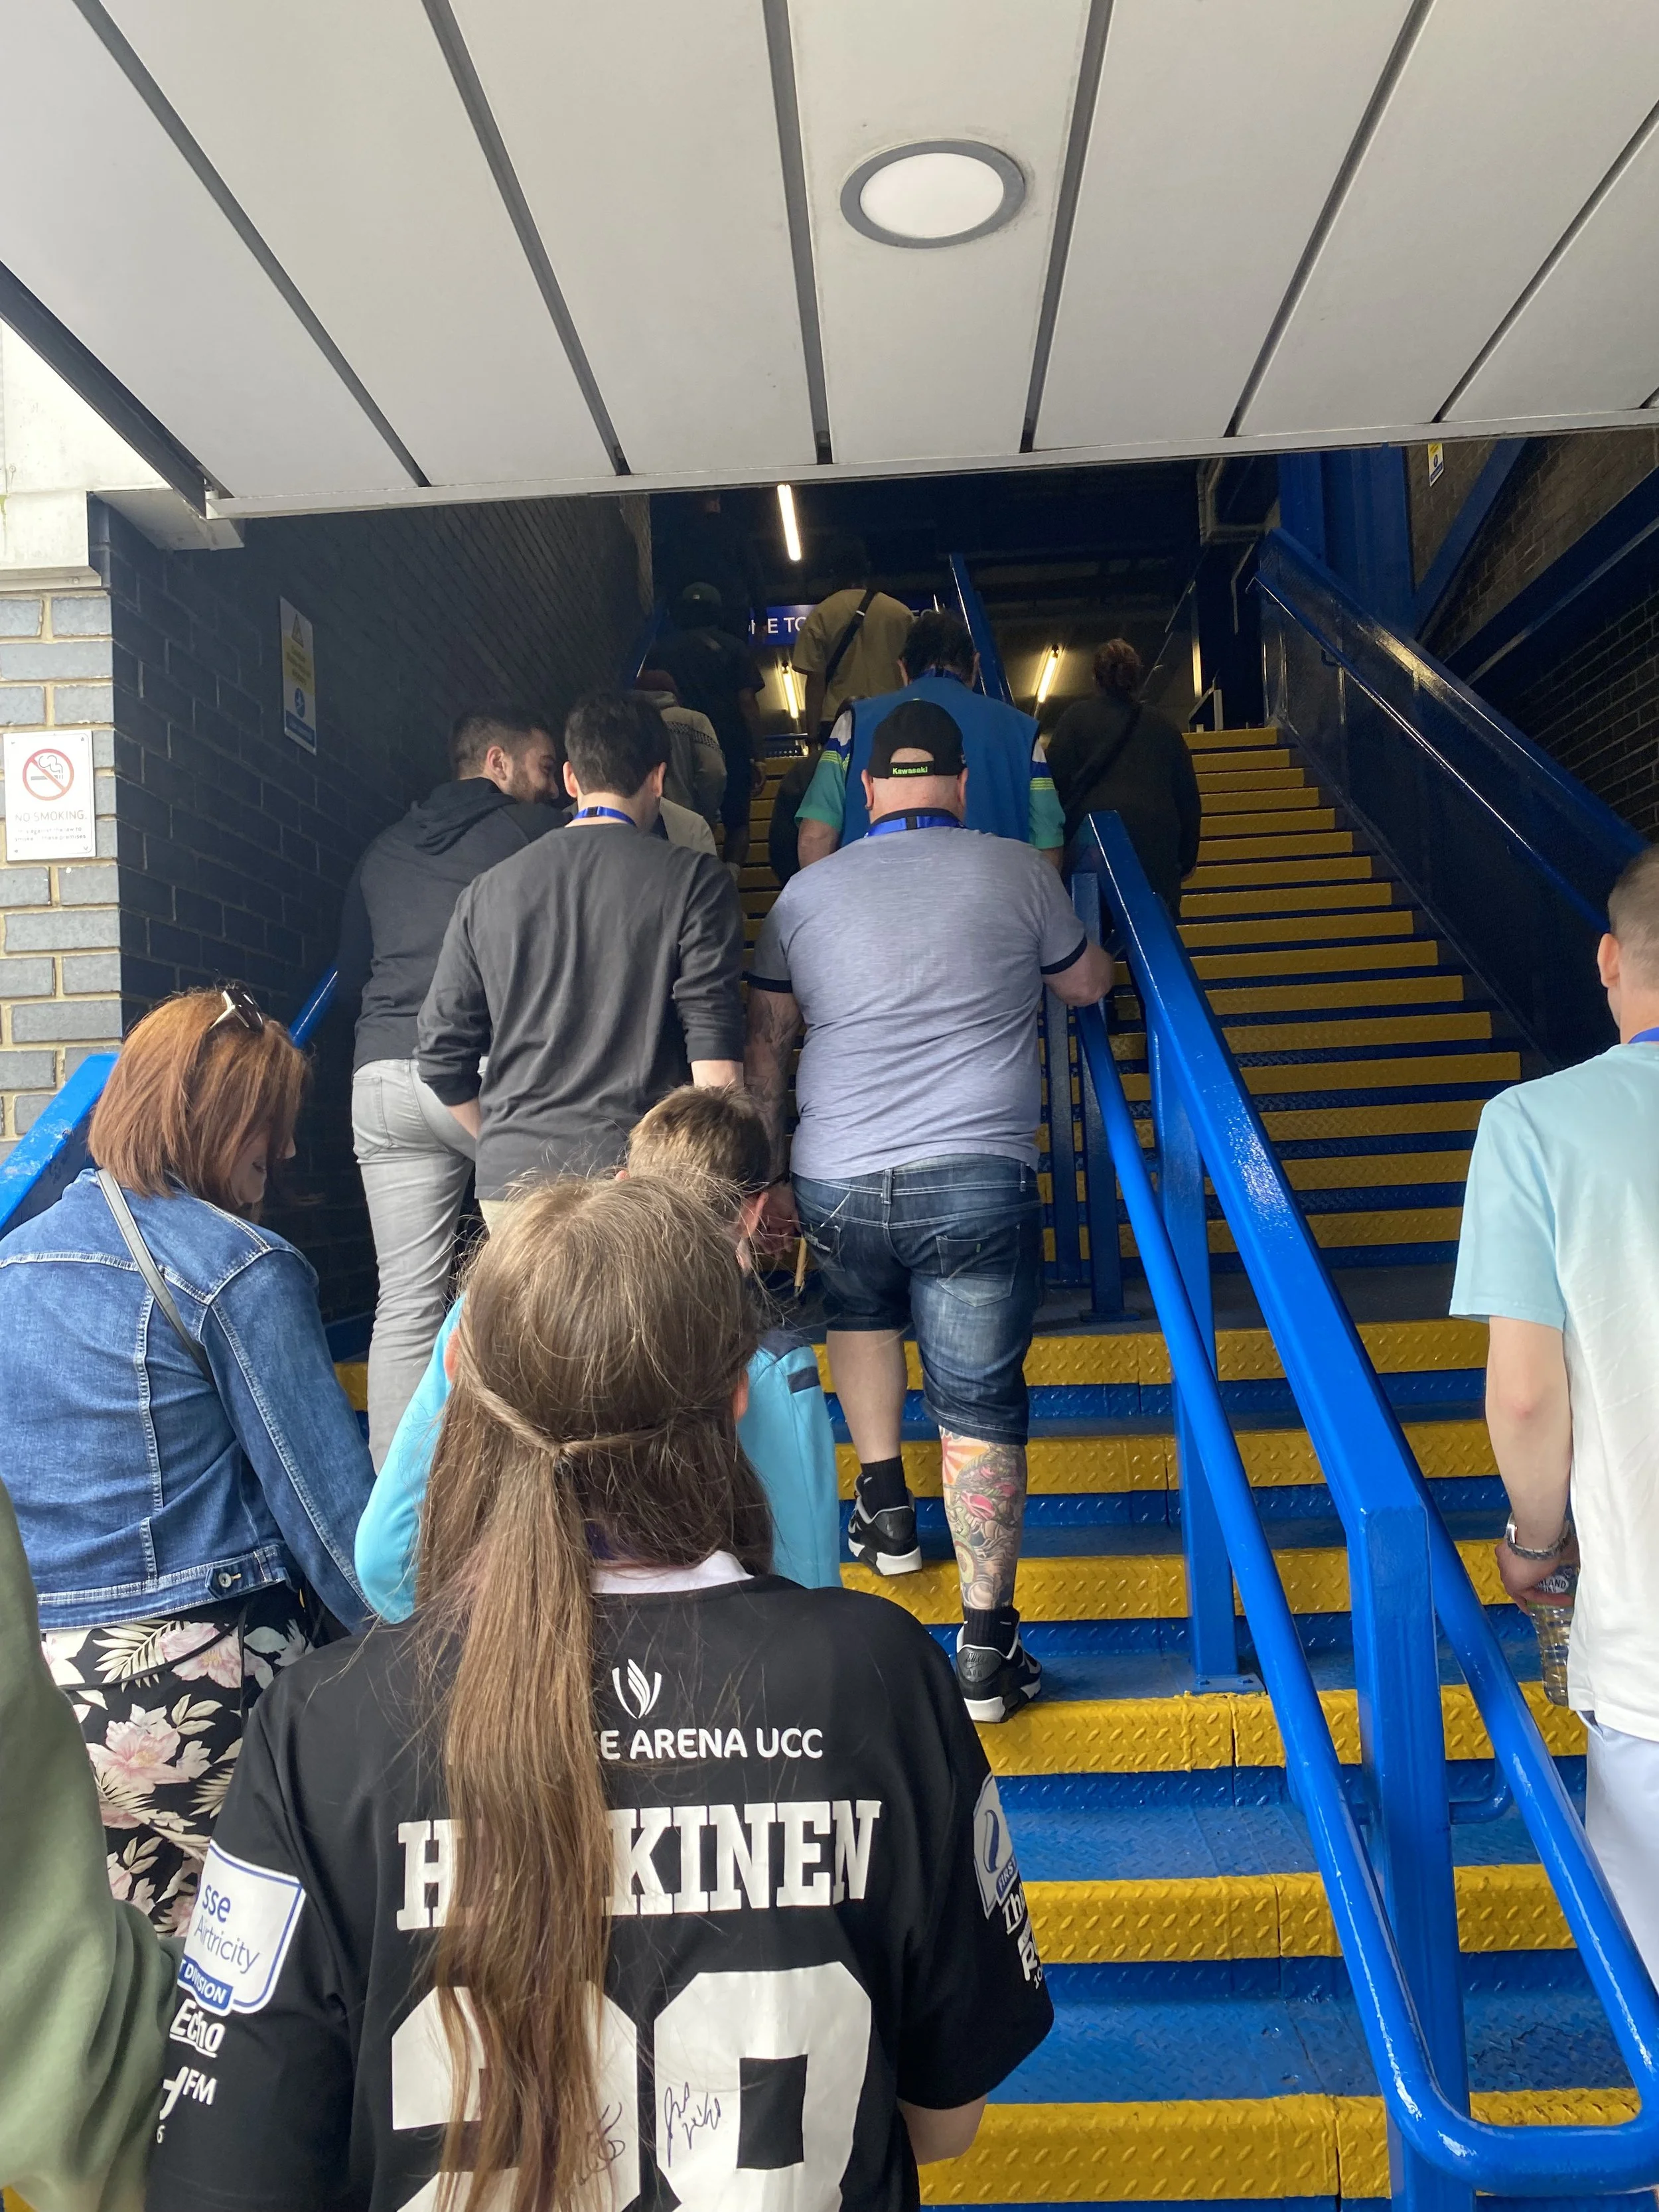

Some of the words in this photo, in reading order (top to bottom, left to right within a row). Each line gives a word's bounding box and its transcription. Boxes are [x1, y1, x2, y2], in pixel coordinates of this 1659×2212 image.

[893, 767, 928, 778] Kawasaki
[15, 812, 31, 822] NO
[630, 1728, 748, 1759] ARENA
[756, 1728, 824, 1759] UCC
[397, 1800, 882, 1929] HKINEN
[202, 1883, 231, 1923] sse
[194, 1916, 261, 1974] Airtricity
[184, 1966, 227, 2006] DIVISION
[169, 1998, 226, 2054] Echo
